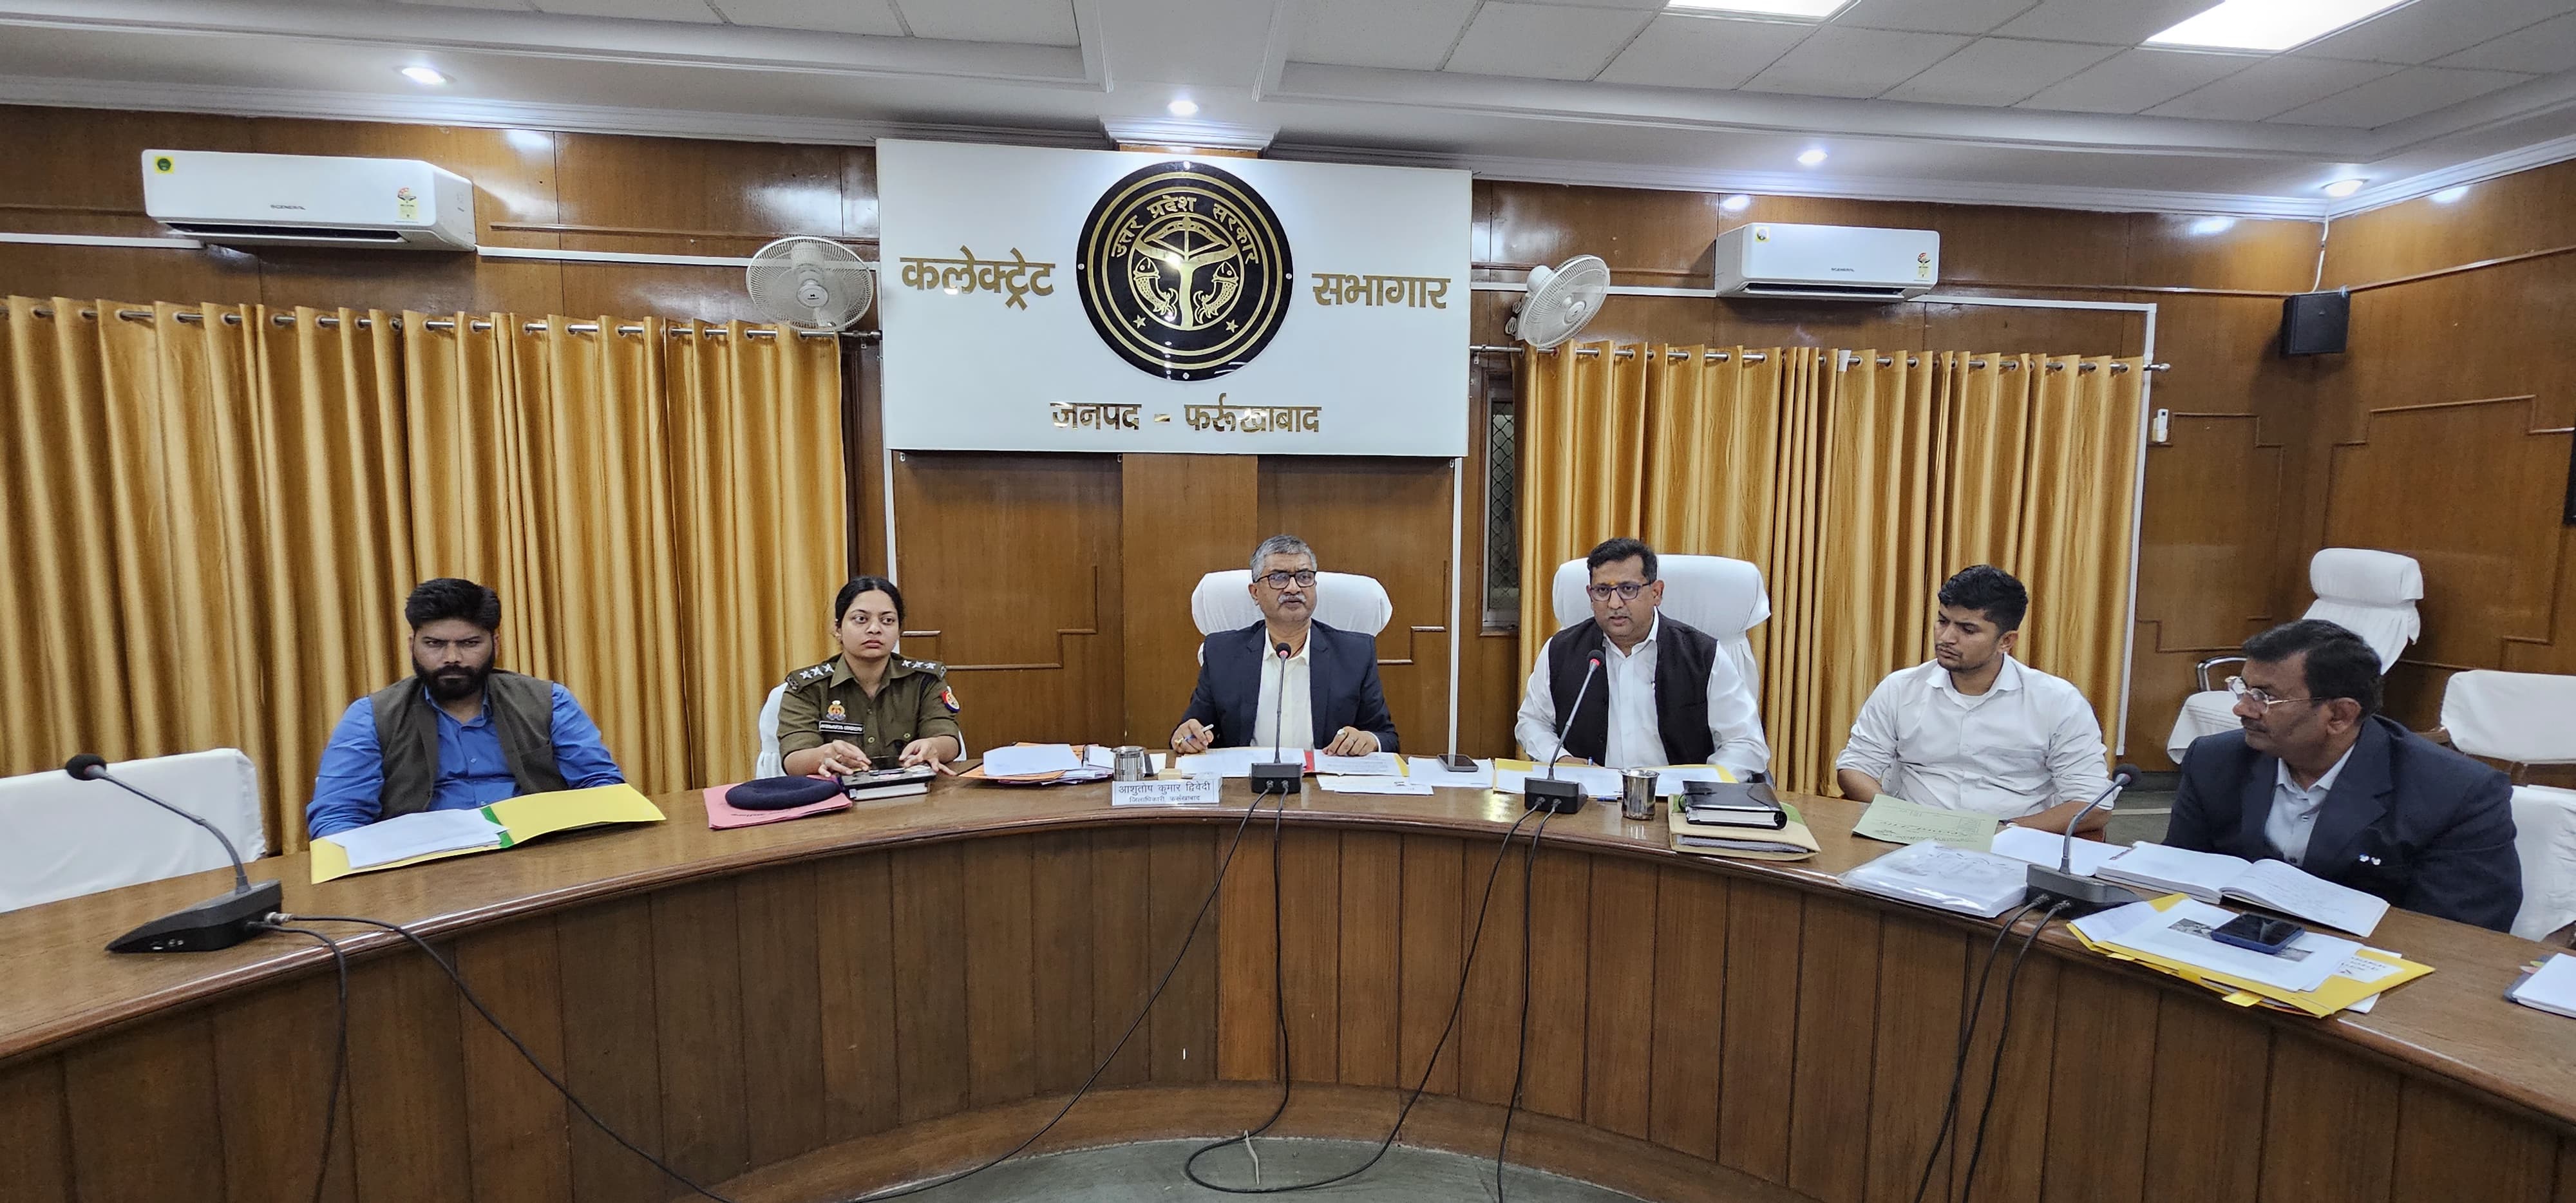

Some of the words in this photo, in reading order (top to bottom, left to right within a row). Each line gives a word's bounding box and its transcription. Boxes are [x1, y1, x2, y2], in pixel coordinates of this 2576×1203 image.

[1111, 215, 1144, 258] उत्तर
[1147, 195, 1197, 218] प्रदेश
[1213, 203, 1259, 265] सरकार
[900, 245, 1056, 310] कलेक्ट्रेट
[1311, 273, 1451, 309] सभागार
[1050, 401, 1142, 430] जनपद
[1158, 784, 1181, 795] कुमार
[1186, 781, 1211, 791] द्विवेदी
